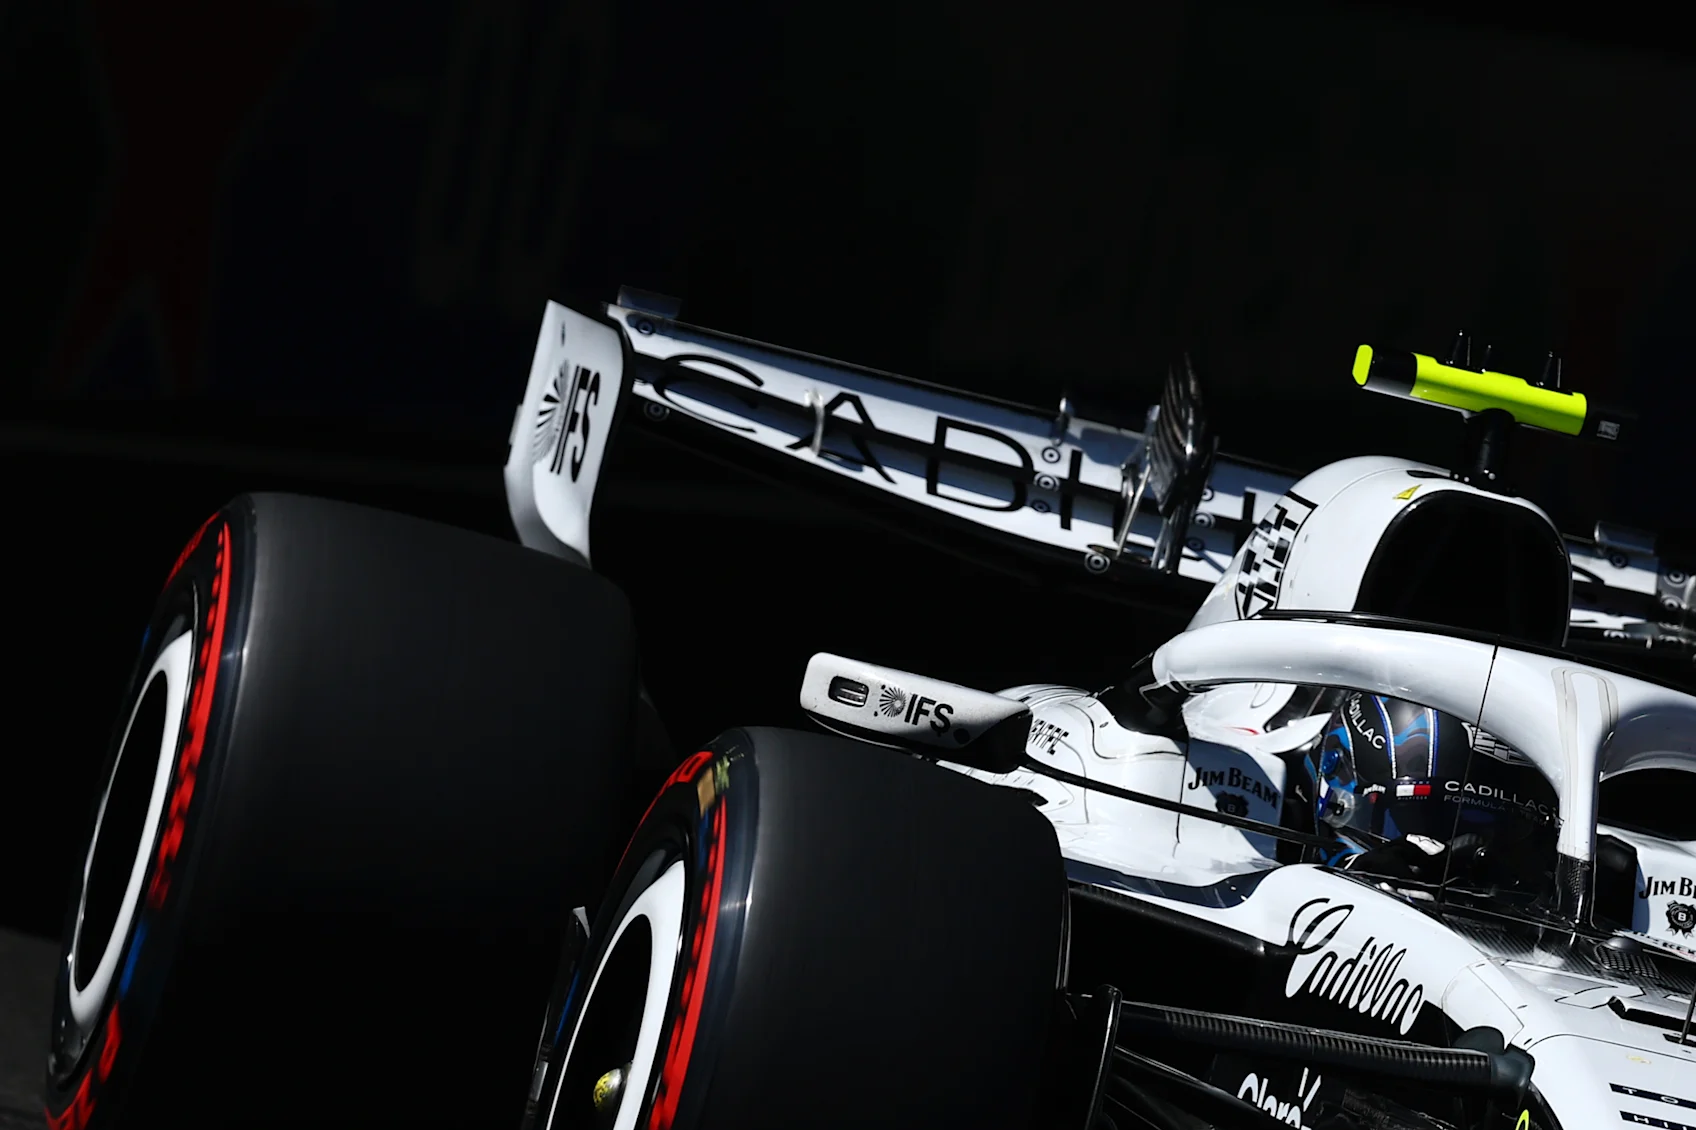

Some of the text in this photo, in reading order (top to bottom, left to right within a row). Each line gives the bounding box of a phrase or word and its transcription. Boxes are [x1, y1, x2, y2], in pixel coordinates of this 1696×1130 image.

[550, 365, 601, 482] IFS
[904, 692, 954, 734] IFS
[1188, 767, 1278, 809] JIM BEAM
[1443, 780, 1550, 815] CADILLAC
[1443, 795, 1506, 813] FORMULA
[1639, 876, 1676, 899] JIM
[1285, 898, 1424, 1036] Cadillac
